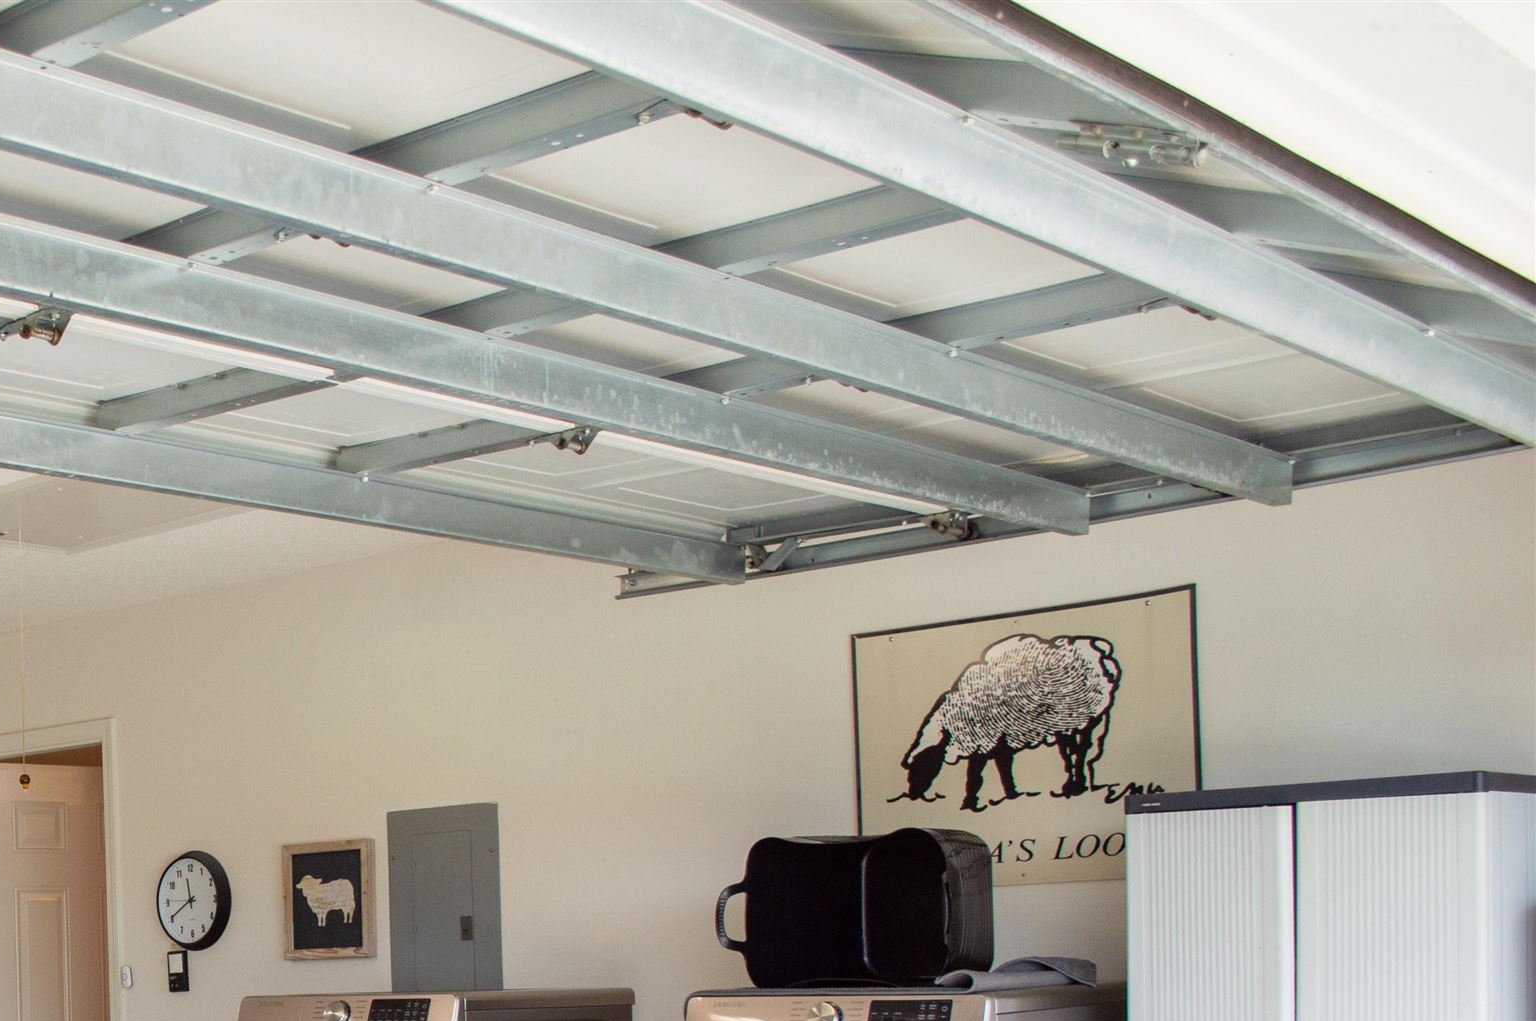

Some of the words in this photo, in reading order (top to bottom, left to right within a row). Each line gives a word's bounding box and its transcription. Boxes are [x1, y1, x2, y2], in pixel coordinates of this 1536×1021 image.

[187, 863, 194, 873] 12
[176, 869, 183, 878] 11
[169, 881, 176, 890] 10
